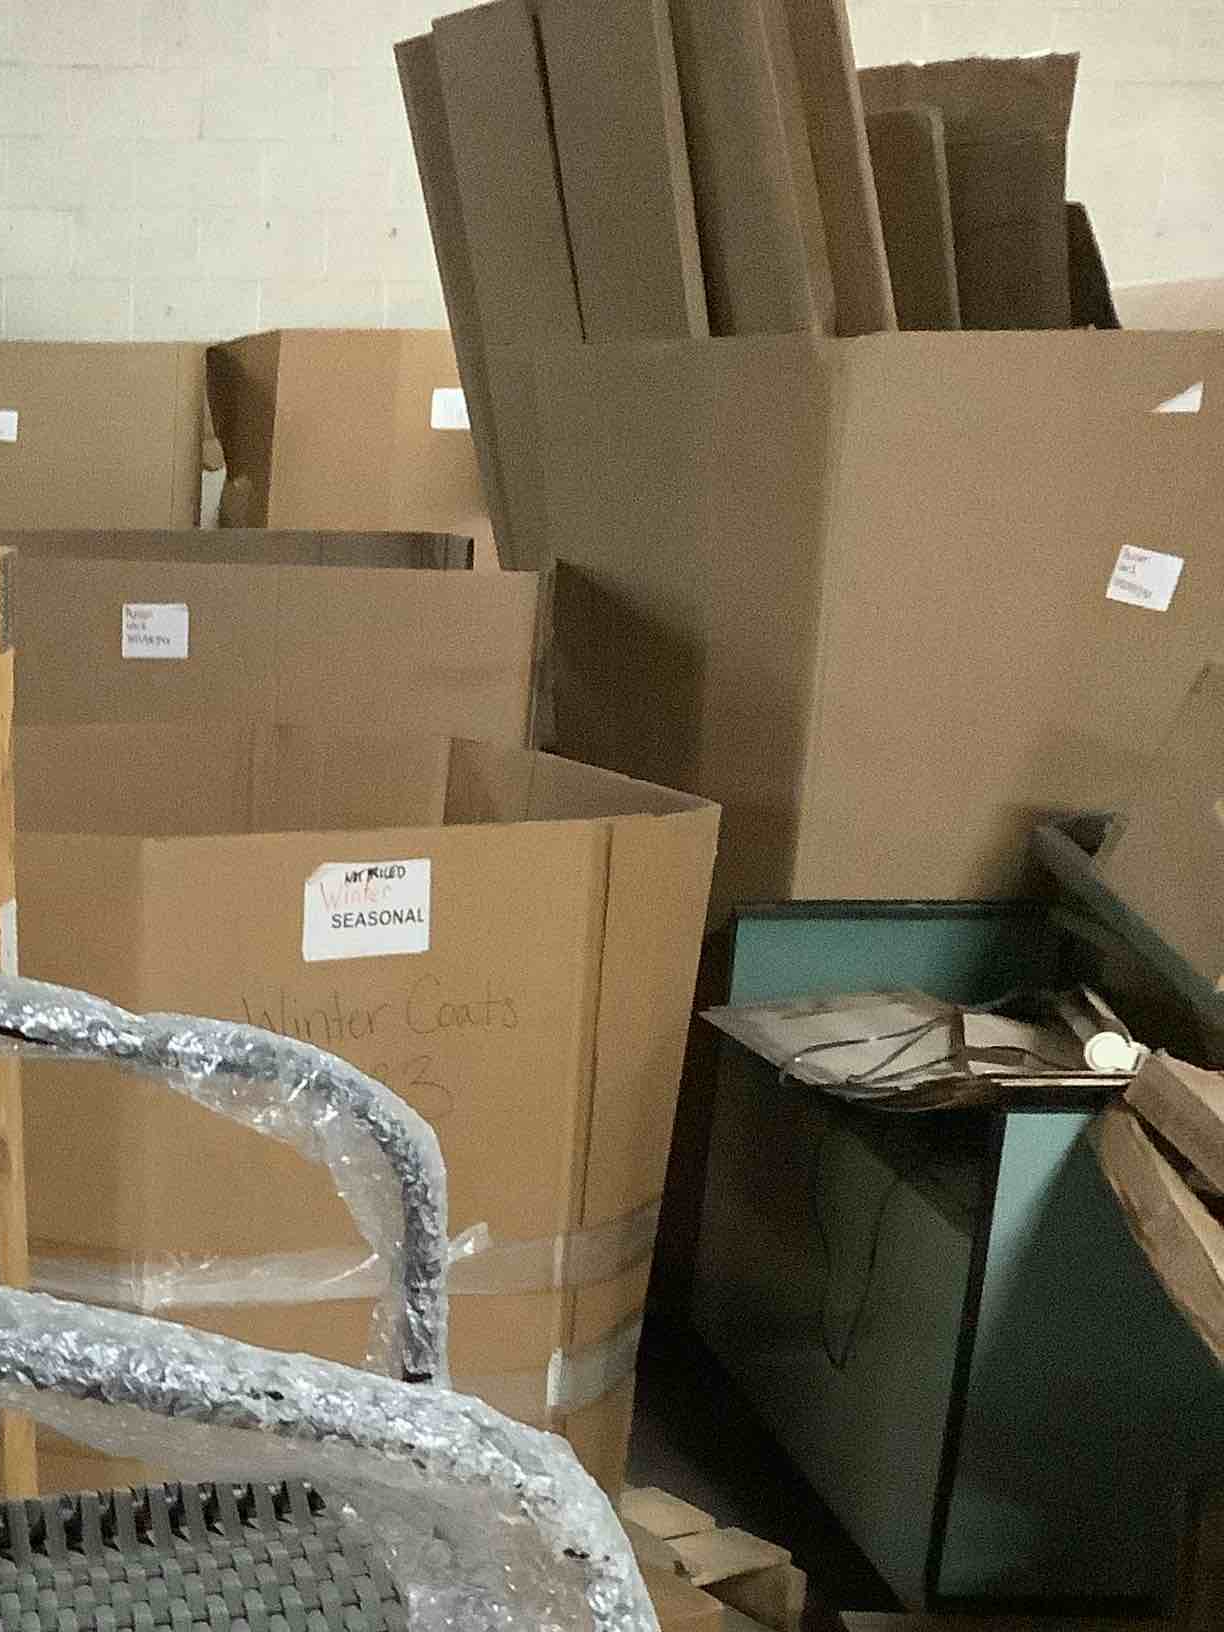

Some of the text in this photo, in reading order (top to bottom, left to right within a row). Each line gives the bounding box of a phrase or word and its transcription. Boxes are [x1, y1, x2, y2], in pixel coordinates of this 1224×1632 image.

[331, 908, 425, 929] SEASONAL
[241, 972, 518, 1044] Winter Coats
